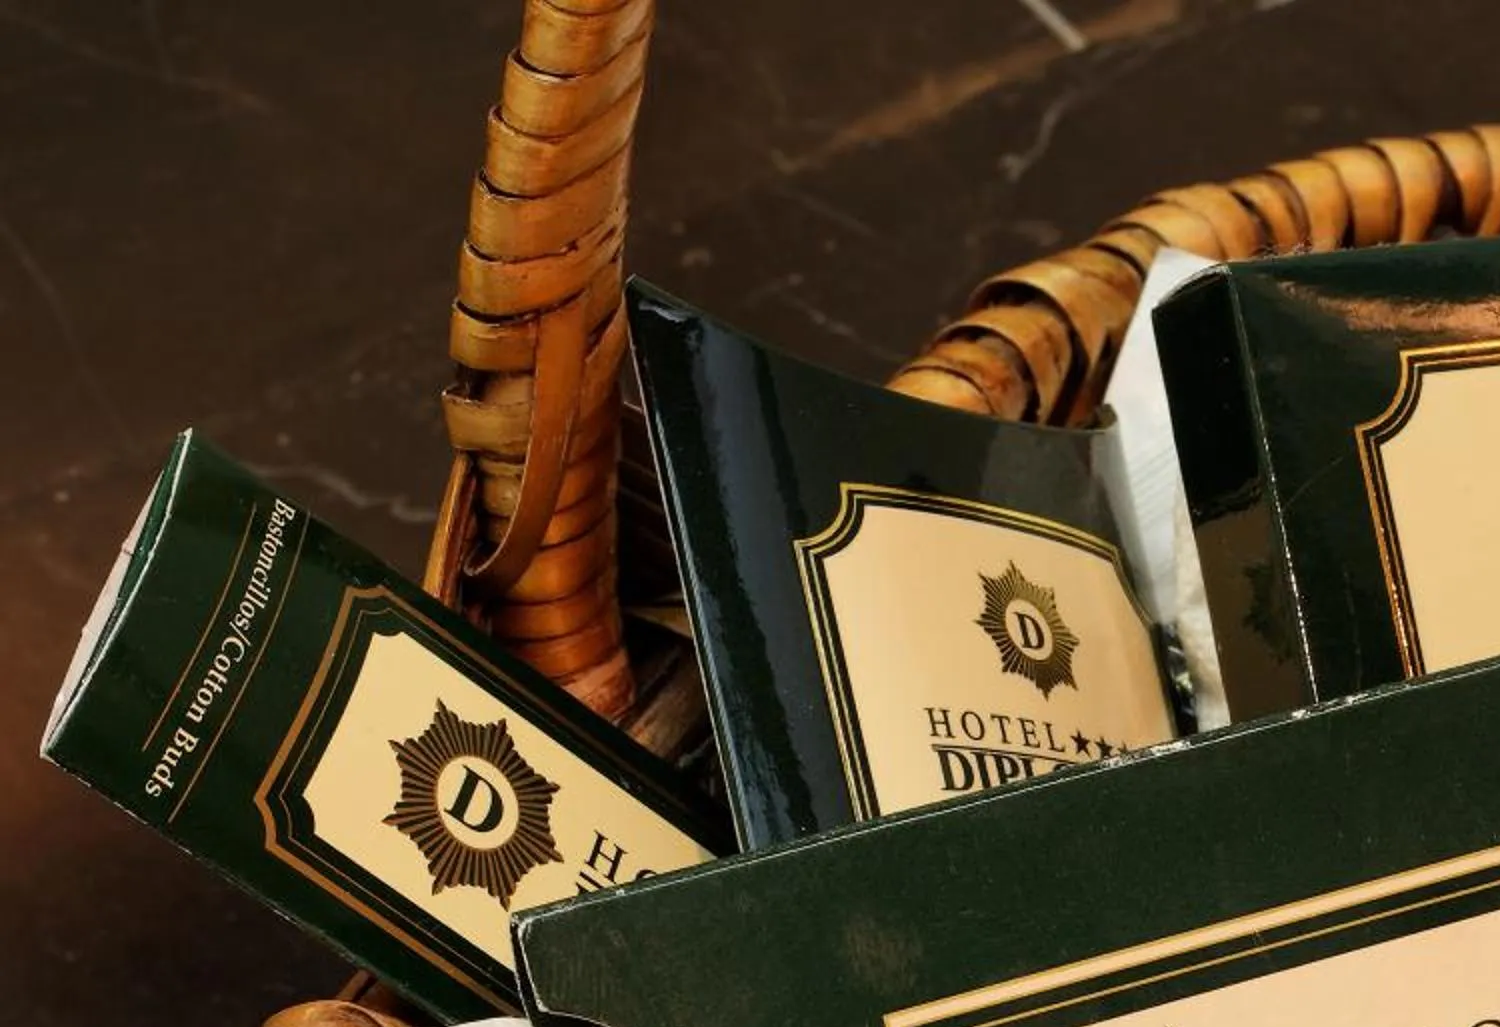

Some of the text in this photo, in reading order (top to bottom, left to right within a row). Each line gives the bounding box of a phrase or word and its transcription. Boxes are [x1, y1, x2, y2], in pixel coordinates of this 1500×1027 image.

[145, 498, 296, 797] Bastoncillos/Cotton Buds
[1015, 611, 1047, 650] D
[924, 706, 1065, 753] HOTEL
[444, 764, 503, 834] D
